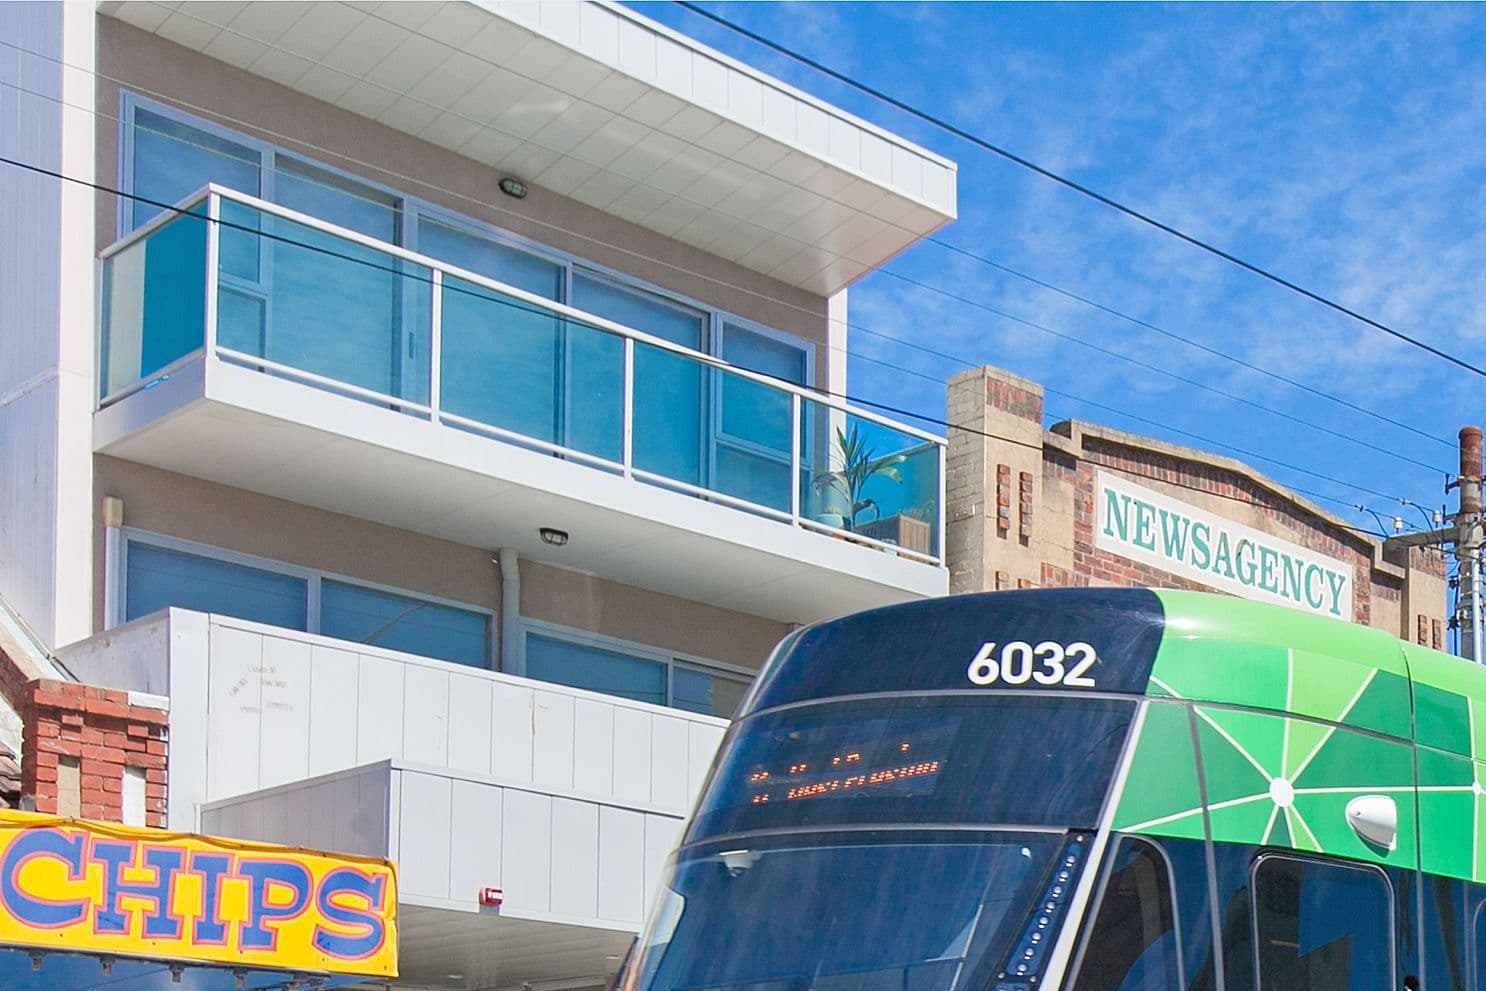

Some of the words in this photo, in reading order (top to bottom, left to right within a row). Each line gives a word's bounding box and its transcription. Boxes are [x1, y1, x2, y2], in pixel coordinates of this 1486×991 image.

[1102, 487, 1347, 617] NEWSAGENCY
[966, 640, 1097, 687] 6032
[0, 826, 388, 961] CHIPS
